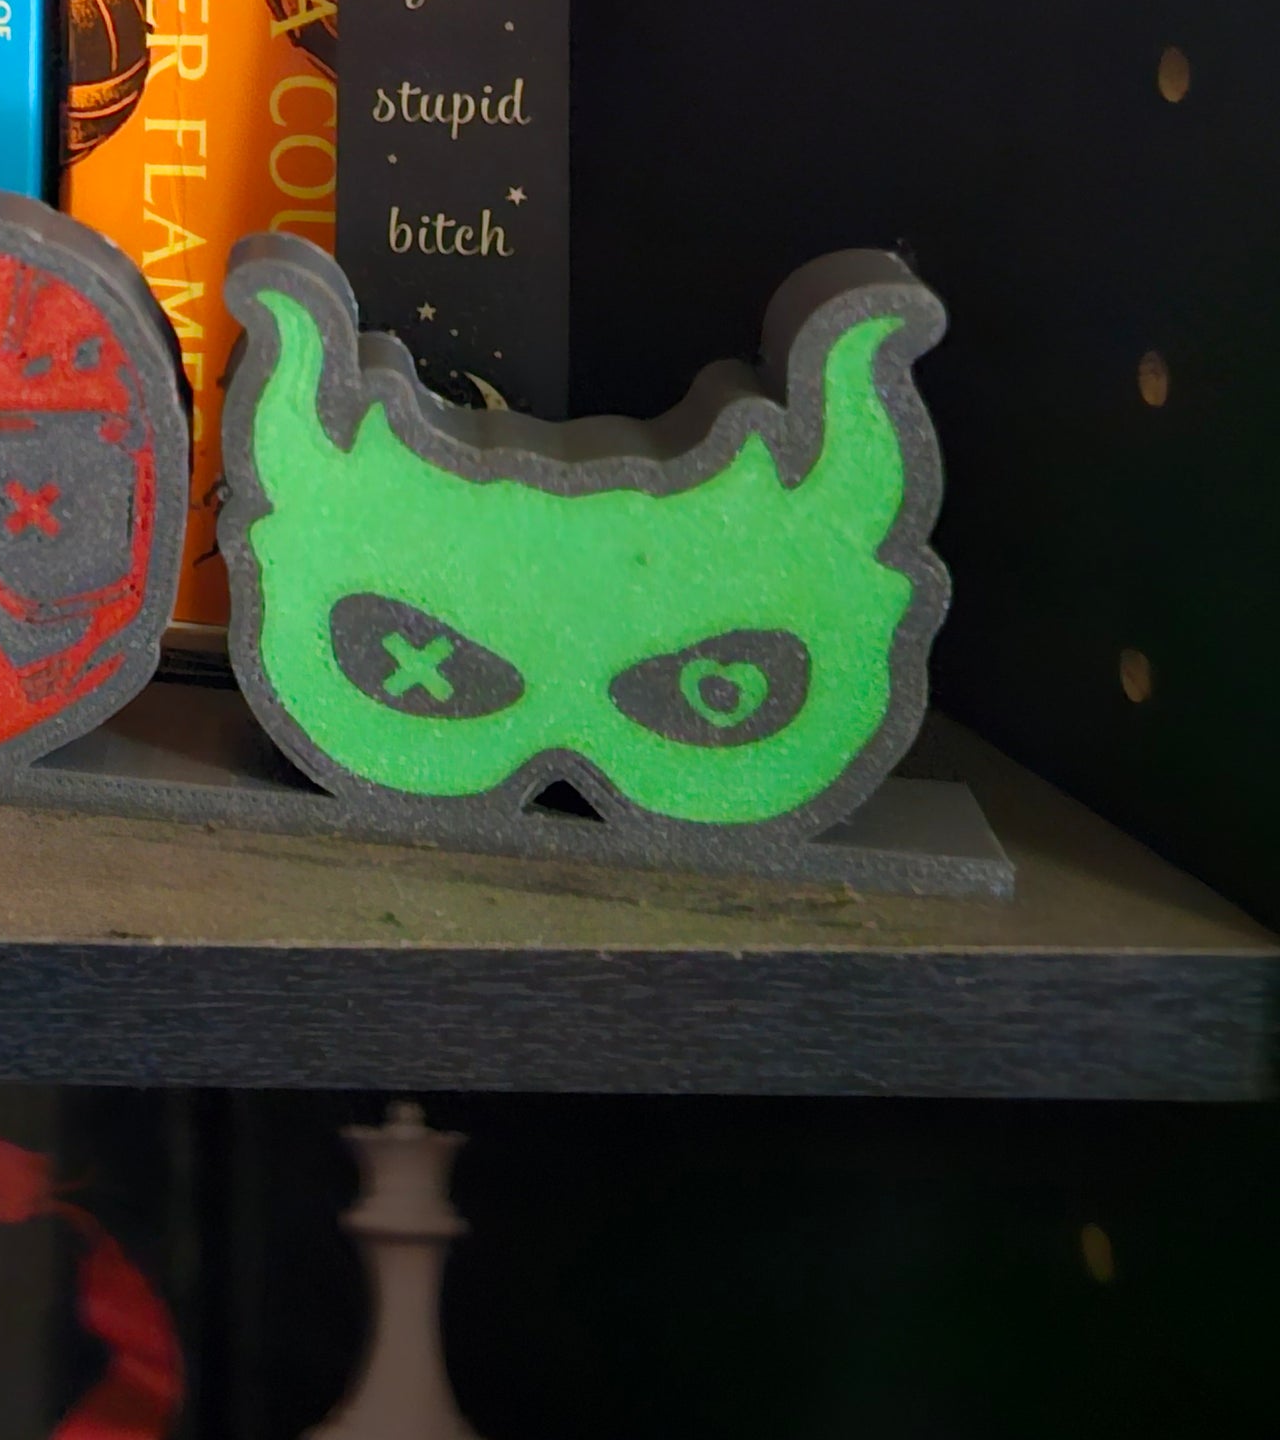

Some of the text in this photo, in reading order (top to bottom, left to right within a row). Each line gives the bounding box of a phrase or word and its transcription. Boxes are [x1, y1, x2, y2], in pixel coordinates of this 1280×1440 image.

[371, 76, 531, 140] stupid
[387, 205, 515, 257] bitch
[142, 117, 208, 442] FLAM
